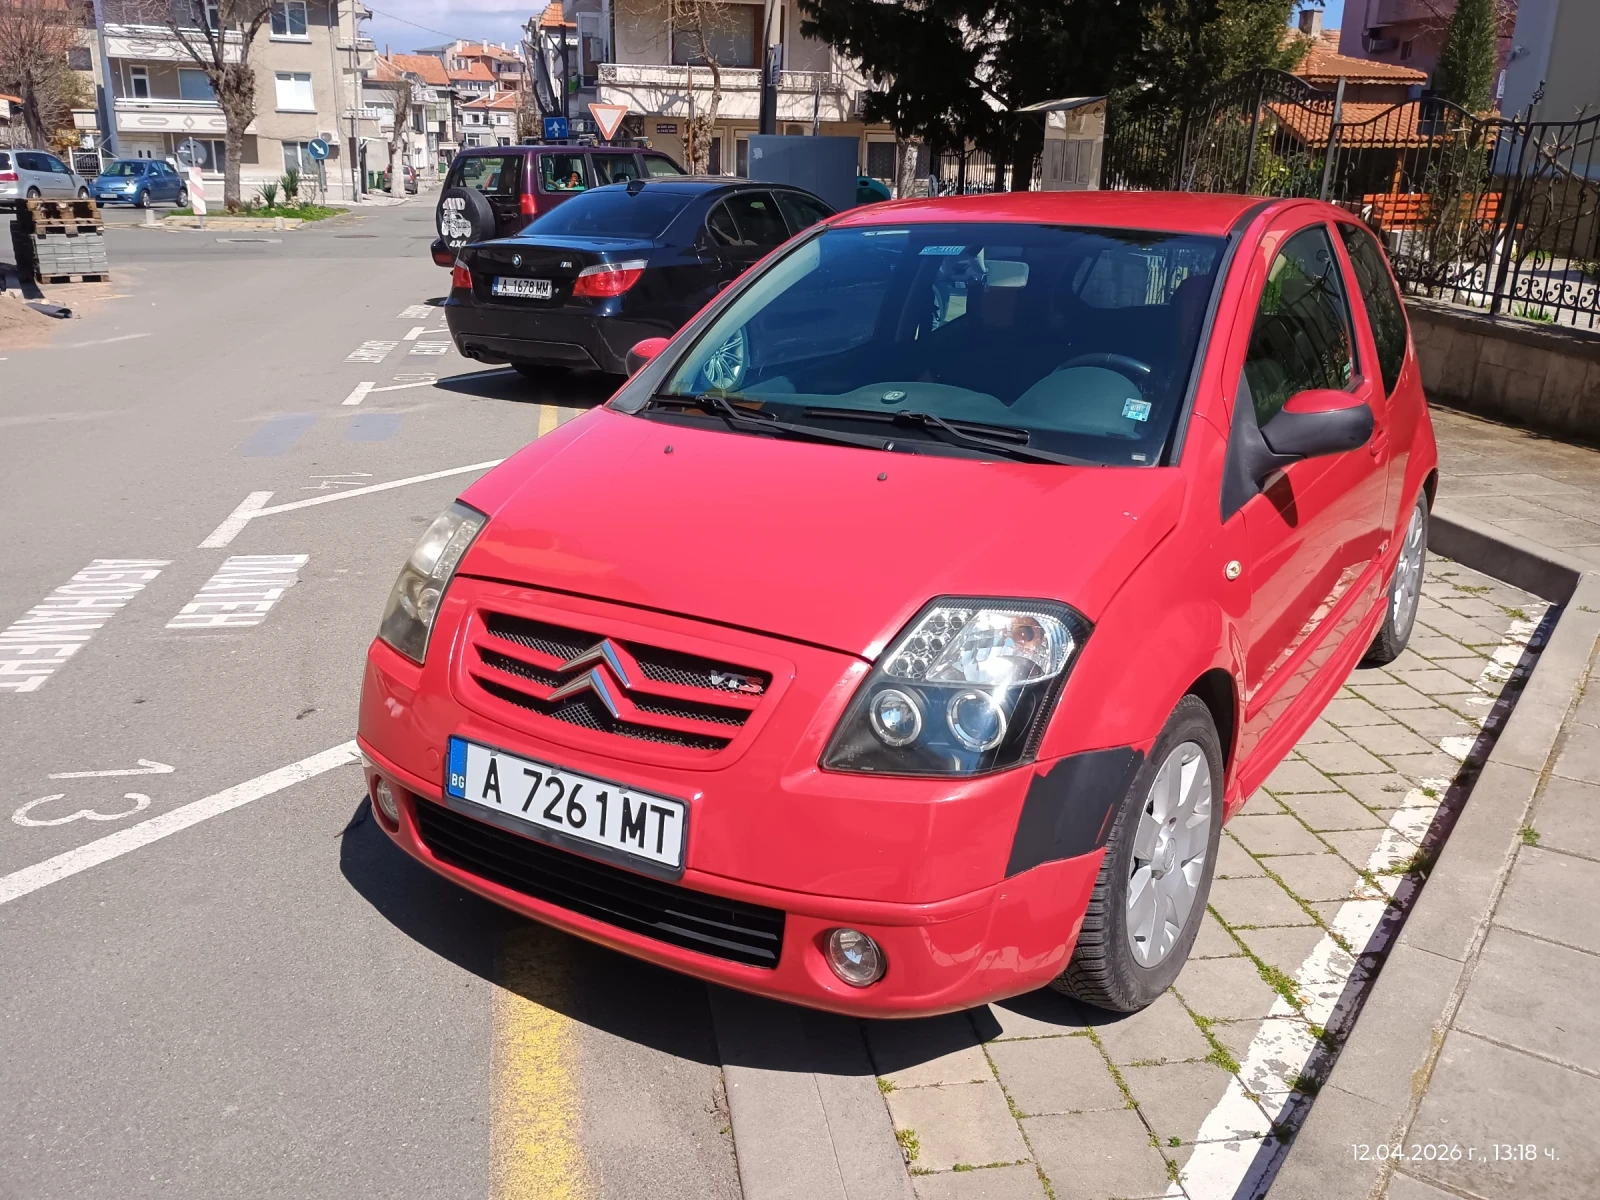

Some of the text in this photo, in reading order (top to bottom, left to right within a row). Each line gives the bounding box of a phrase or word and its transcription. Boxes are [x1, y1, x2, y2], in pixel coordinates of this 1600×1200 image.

[513, 280, 535, 293] 1678
[536, 281, 549, 295] MM
[0, 558, 176, 693] АБОНАМЕНТ
[164, 553, 310, 629] ПЛАТЕН
[11, 758, 176, 827] 13
[451, 773, 465, 789] BG
[481, 757, 675, 854] A 7261 MT
